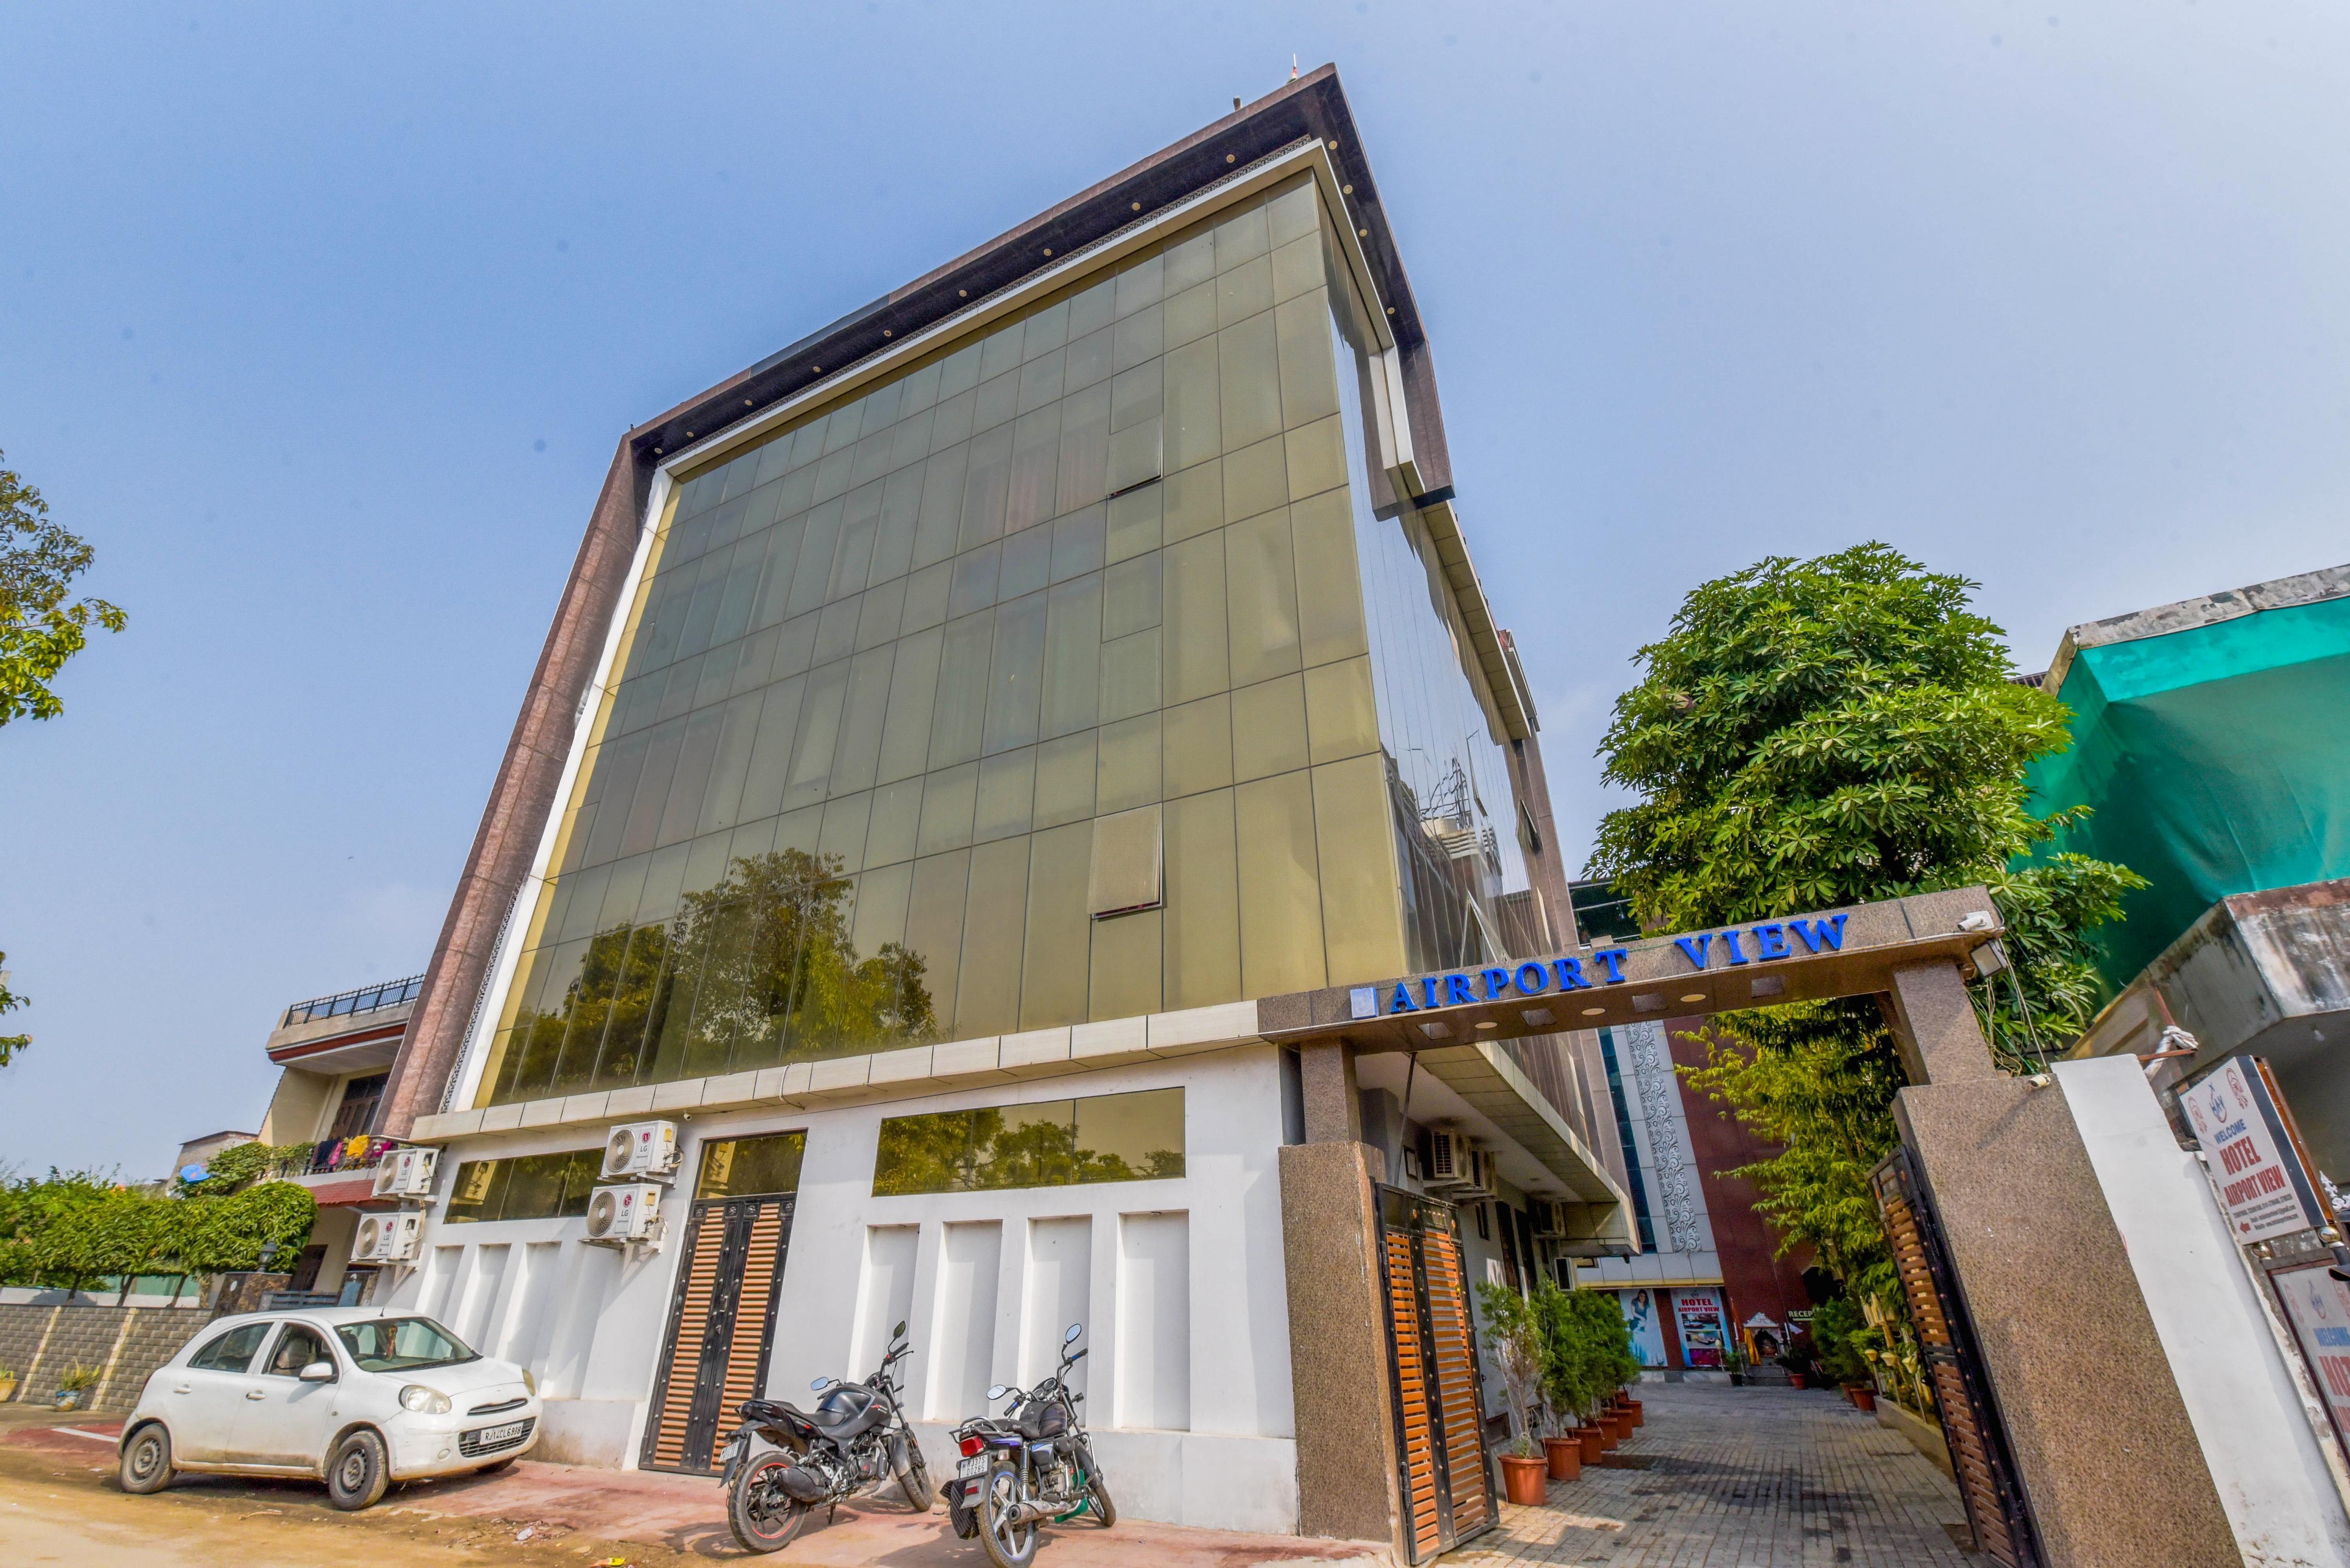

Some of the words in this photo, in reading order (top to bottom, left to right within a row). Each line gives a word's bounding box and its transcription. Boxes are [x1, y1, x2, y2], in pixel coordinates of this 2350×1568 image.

[1389, 948, 1628, 1014] AIRPORT
[1674, 913, 1849, 969] VIEW
[2213, 1118, 2247, 1145] WELCOME
[2219, 1136, 2262, 1175] HOTEL
[2224, 1175, 2262, 1207] AIRPORT
[2256, 1164, 2286, 1194] VIEW
[967, 1456, 985, 1467] RJ37S
